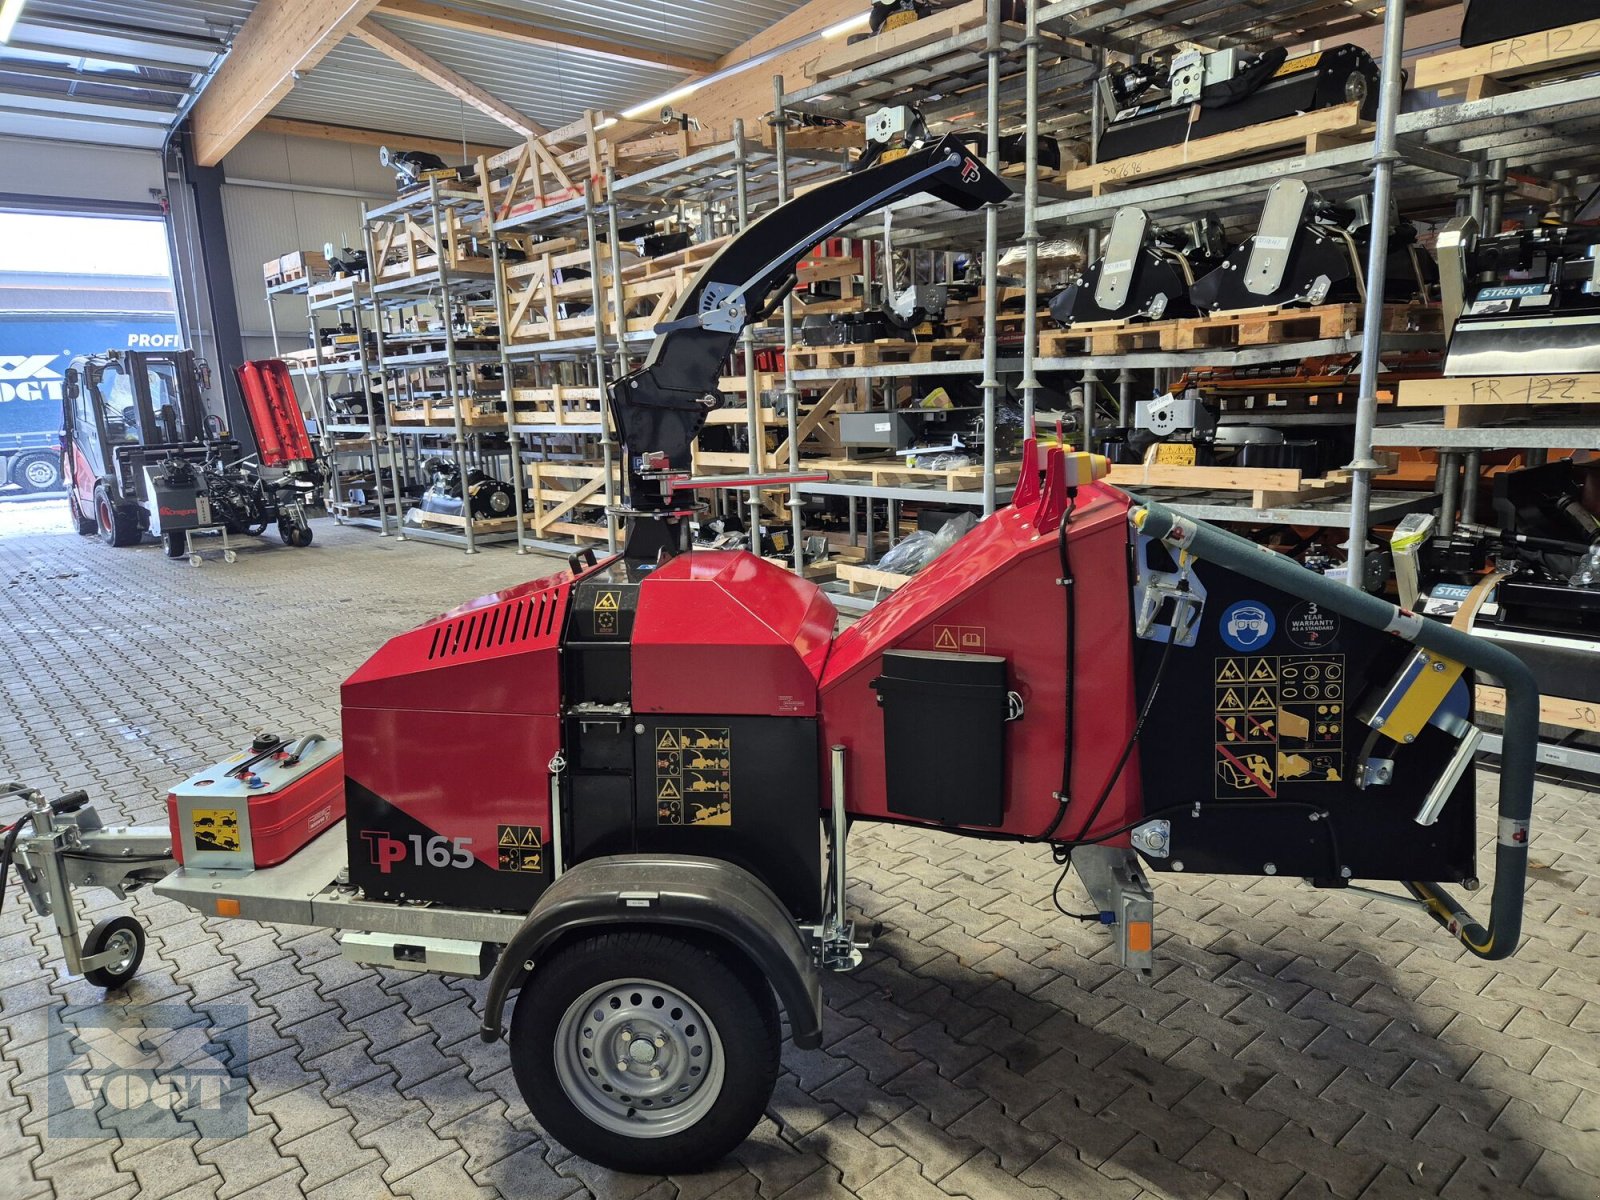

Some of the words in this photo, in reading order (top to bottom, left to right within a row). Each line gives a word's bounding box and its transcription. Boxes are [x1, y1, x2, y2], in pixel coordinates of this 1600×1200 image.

[961, 156, 981, 184] TP
[1481, 286, 1536, 298] STRENX
[127, 333, 179, 347] PROFI
[1435, 586, 1470, 598] STRE
[1308, 602, 1318, 614] 3
[360, 830, 407, 873] TP
[408, 834, 475, 869] 165
